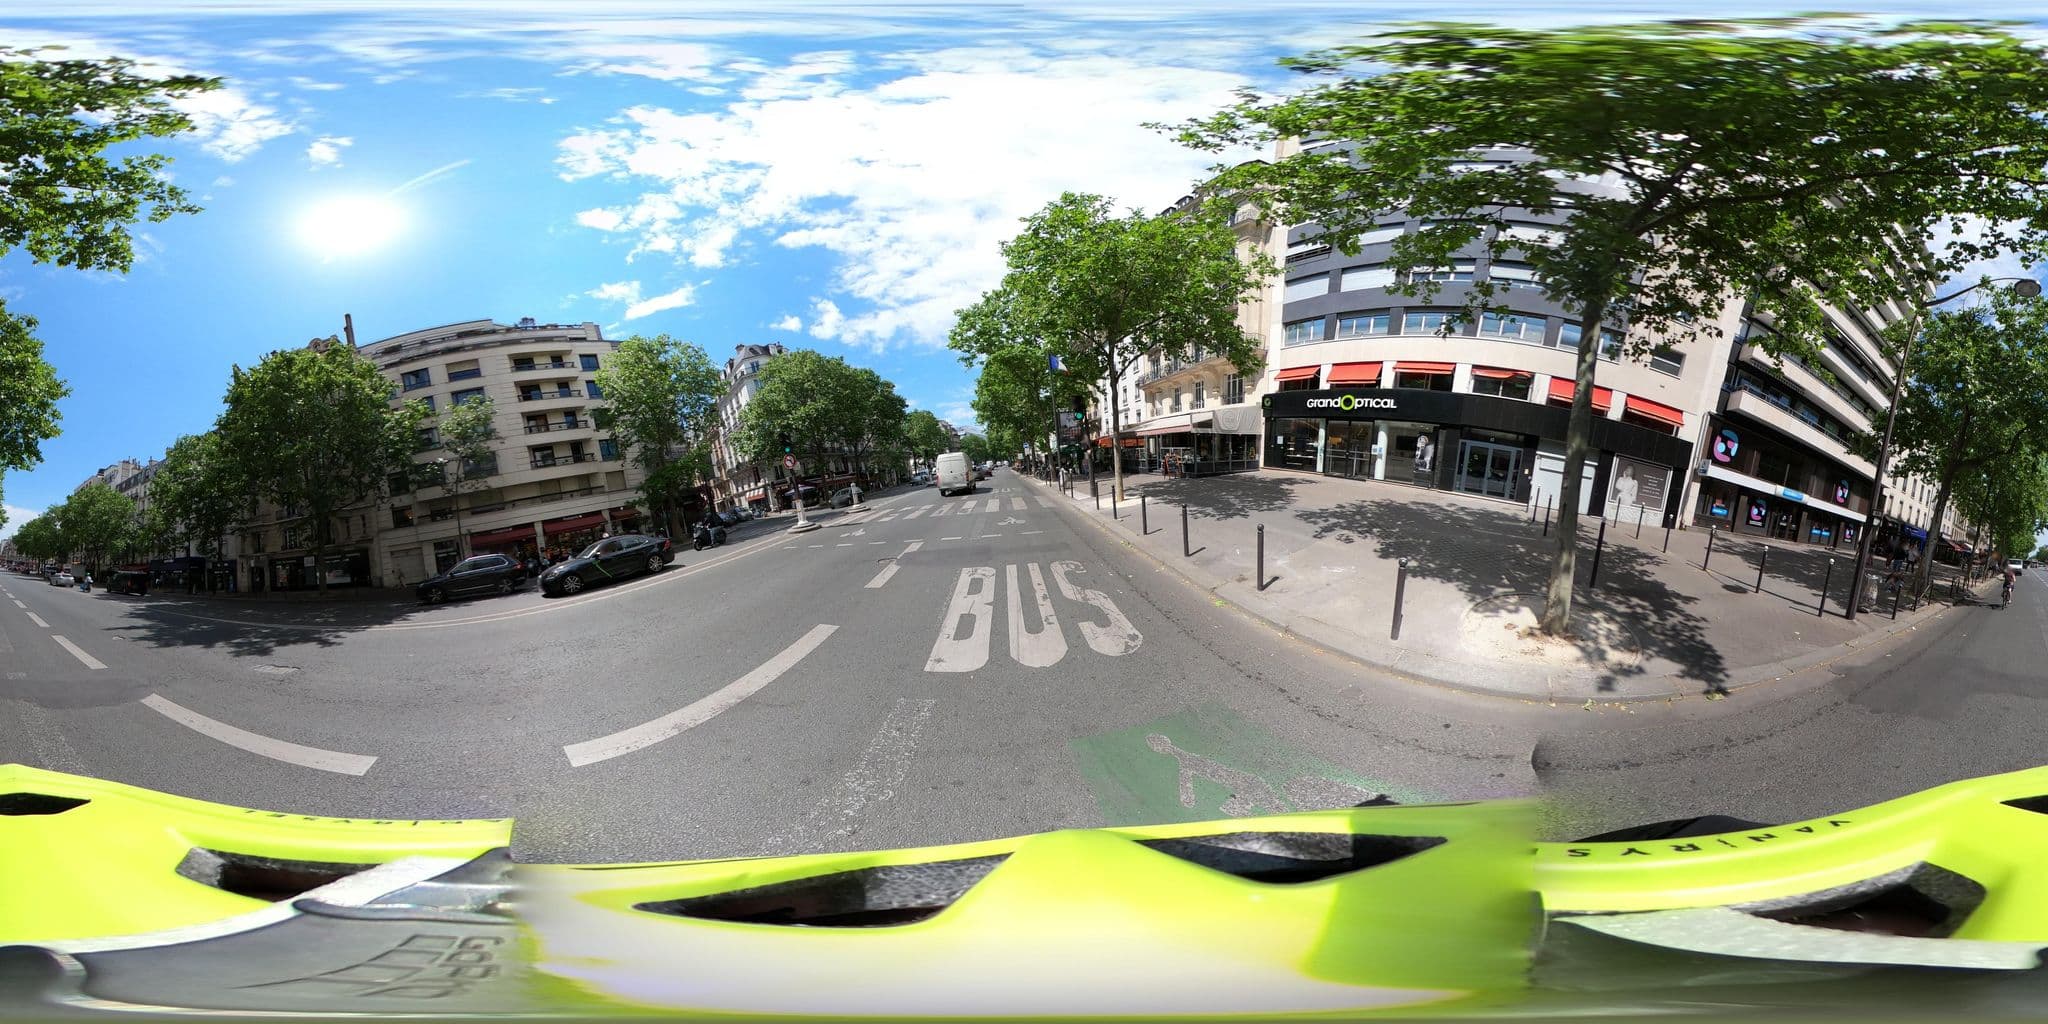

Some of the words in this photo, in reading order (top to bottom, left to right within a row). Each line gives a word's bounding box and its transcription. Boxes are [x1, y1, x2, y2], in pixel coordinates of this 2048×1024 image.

[923, 560, 1144, 673] BUS
[1747, 819, 1851, 843] VAN
[1528, 843, 1703, 858] RYS
